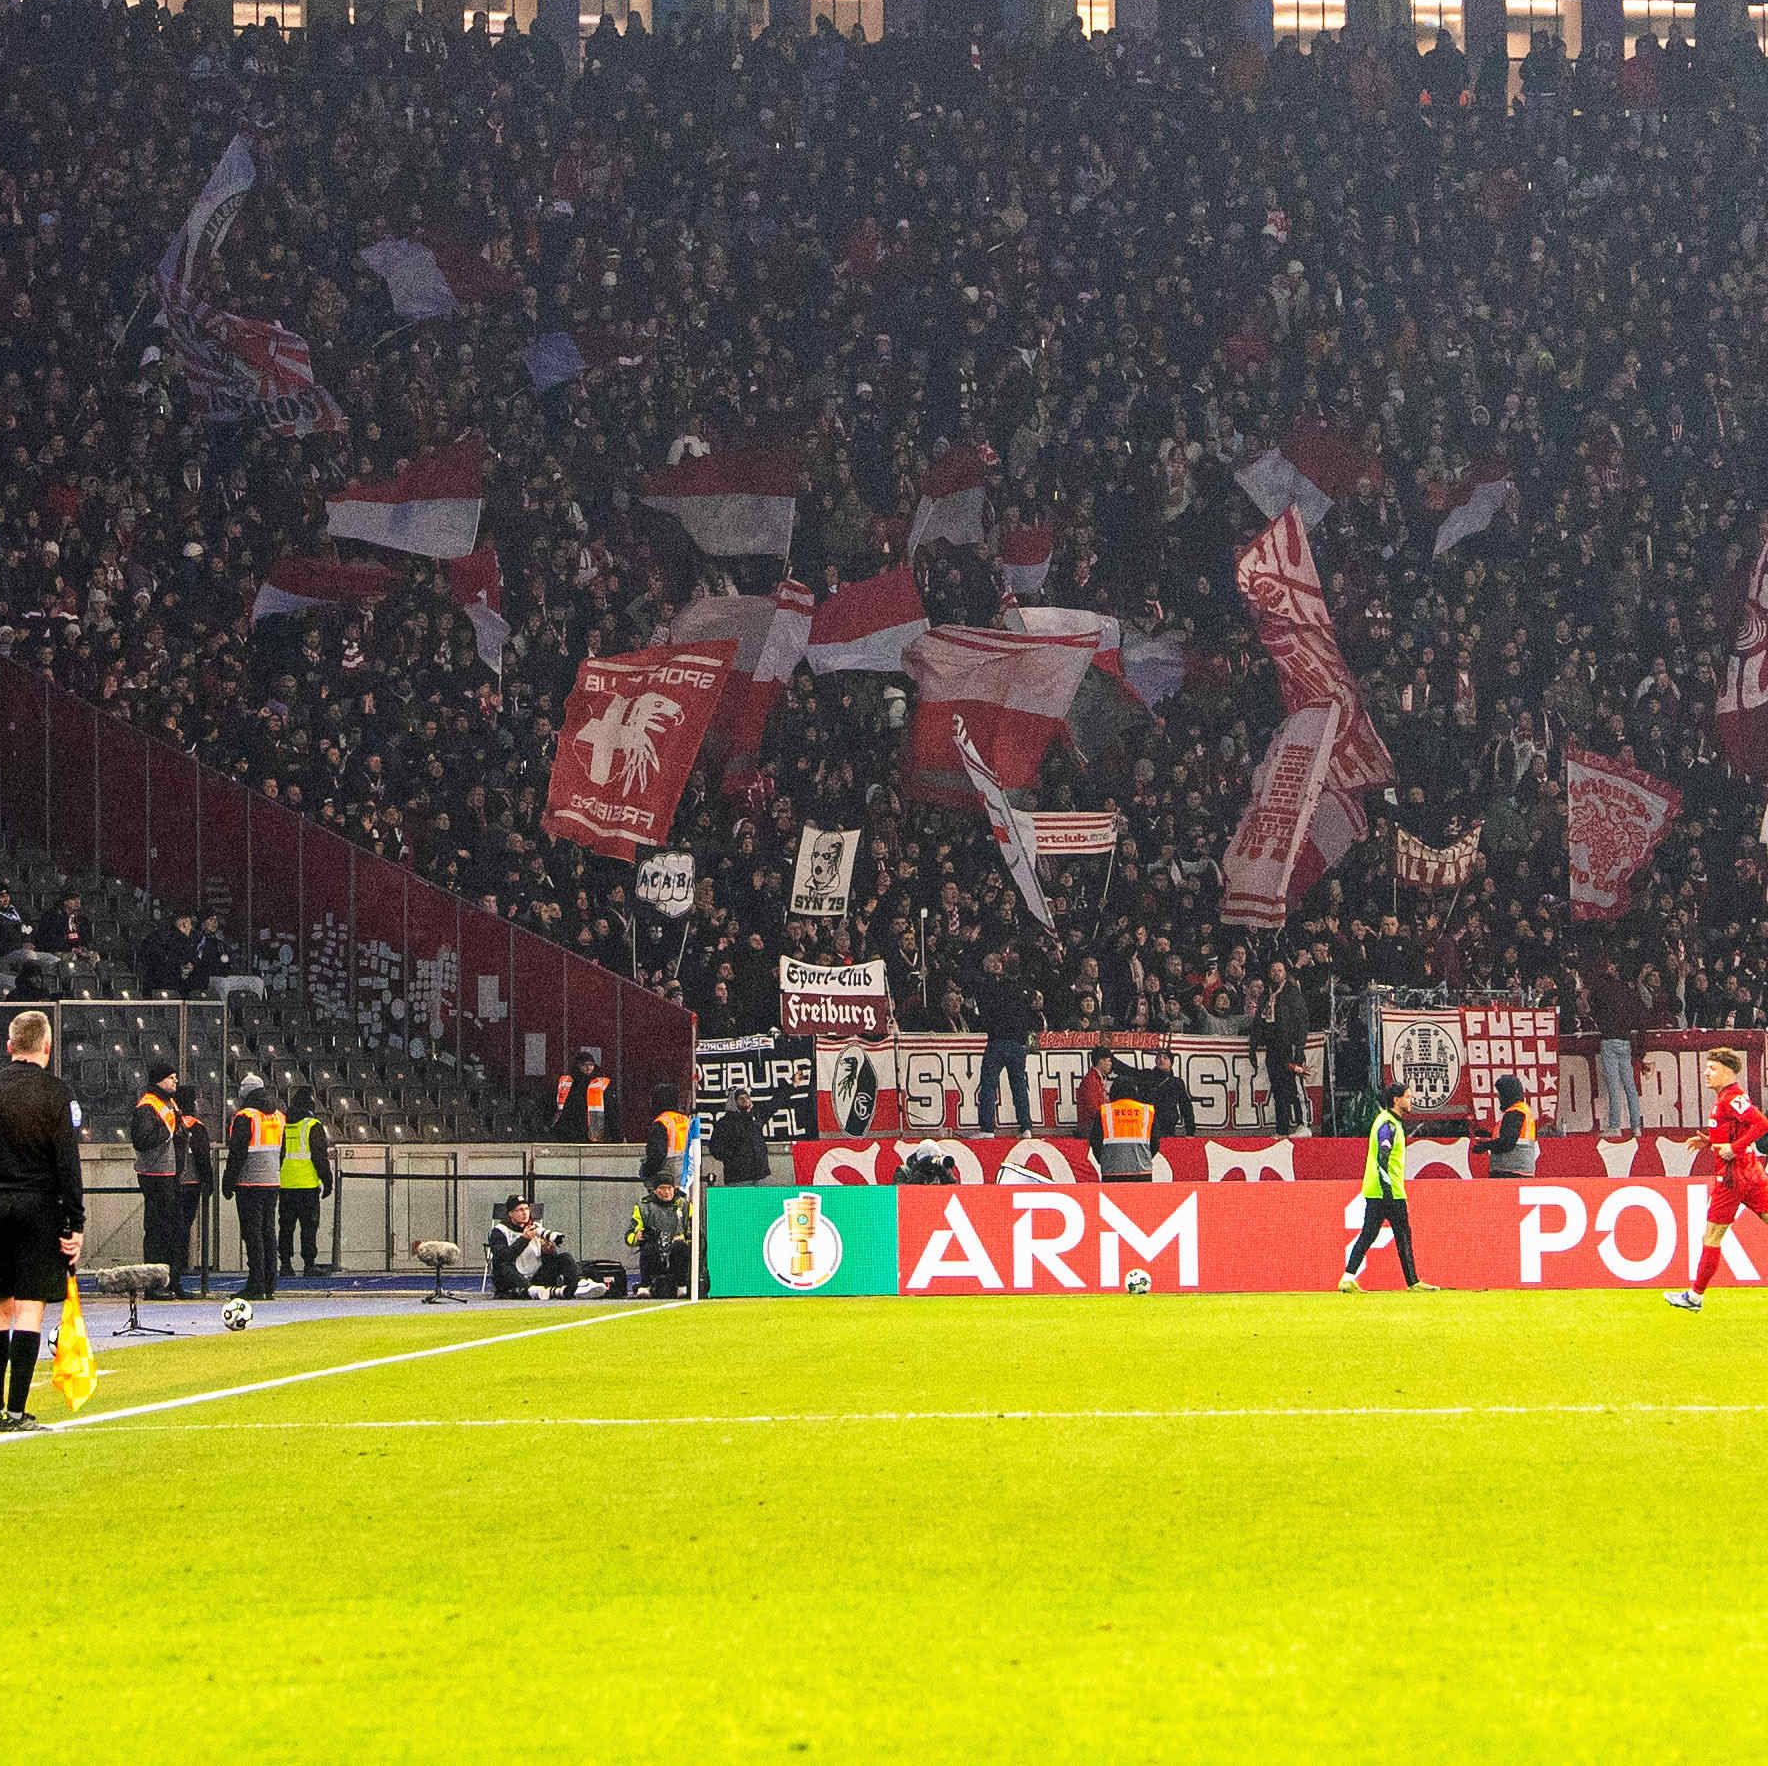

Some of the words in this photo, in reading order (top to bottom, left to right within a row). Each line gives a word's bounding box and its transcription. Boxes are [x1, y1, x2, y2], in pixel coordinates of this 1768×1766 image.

[638, 871, 687, 889] ACAB
[794, 895, 822, 911] SYN
[826, 895, 846, 911] 79
[786, 963, 873, 989] Sport-Club
[787, 994, 878, 1031] Freiburg
[1464, 1010, 1556, 1037] FUSS
[1466, 1039, 1558, 1066] BALL
[905, 1190, 1199, 1290] ARM
